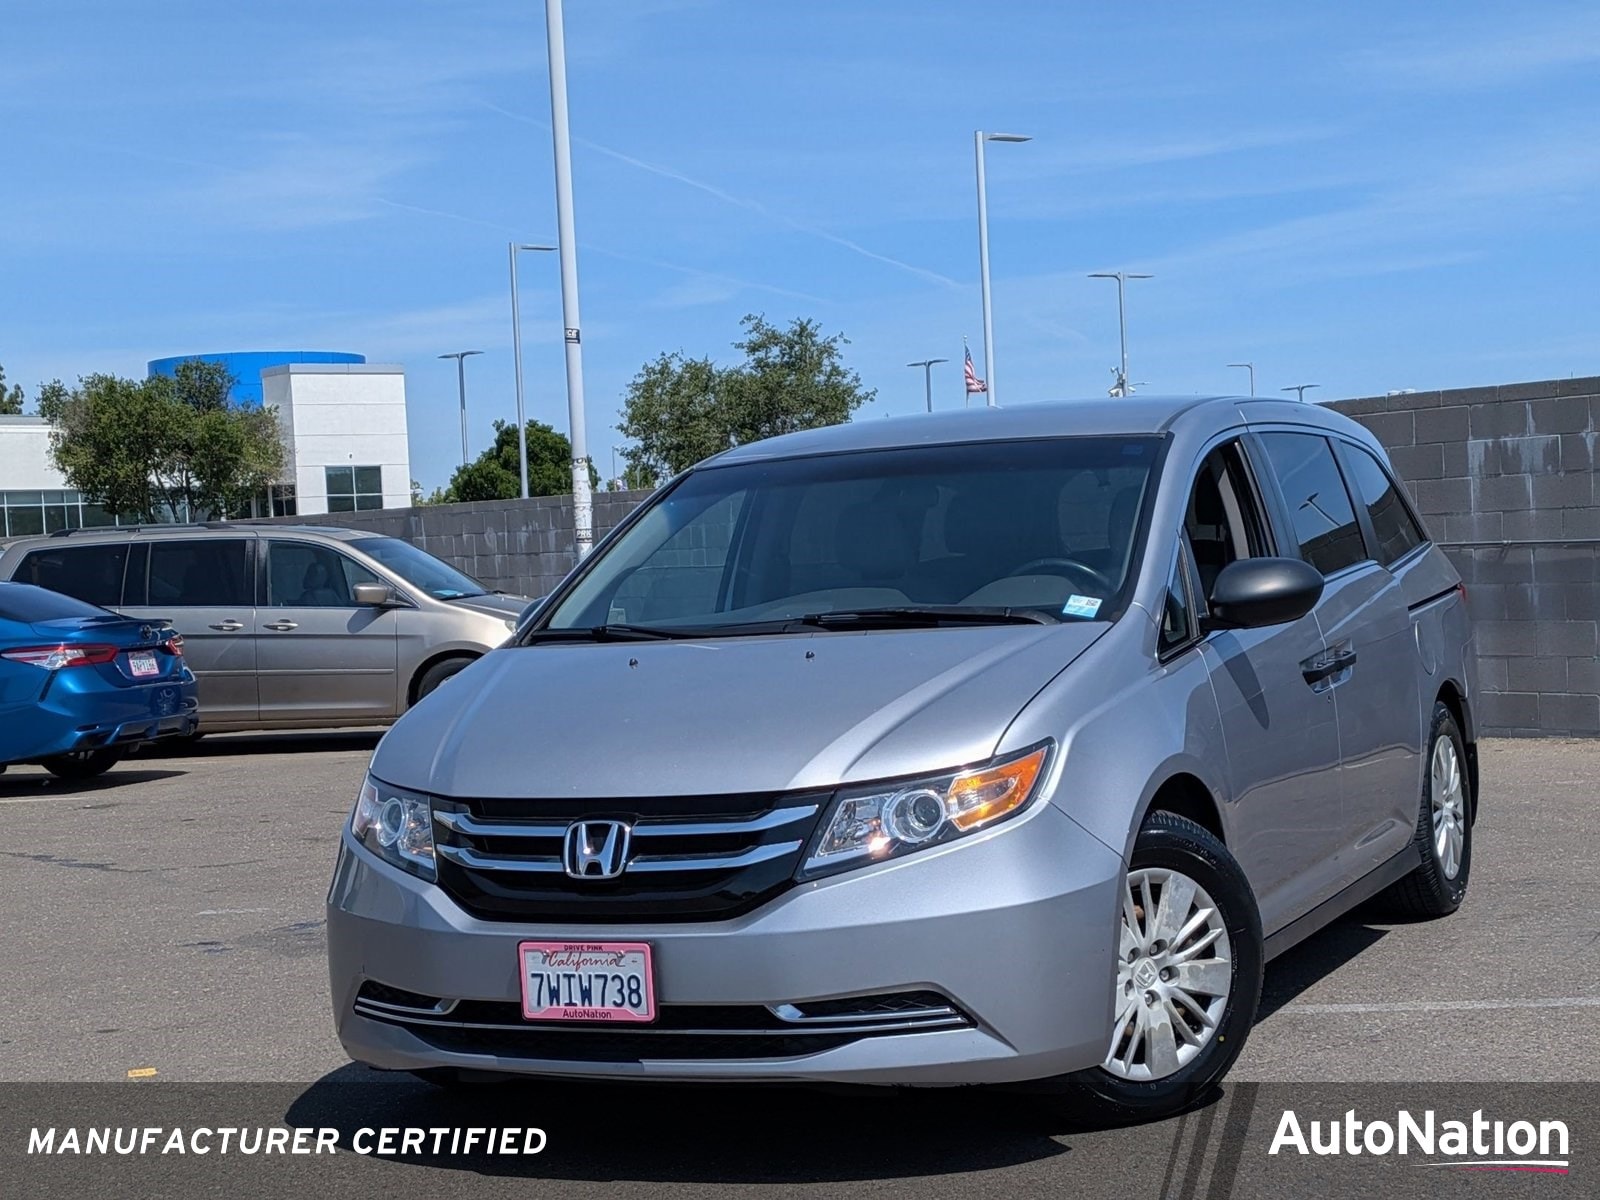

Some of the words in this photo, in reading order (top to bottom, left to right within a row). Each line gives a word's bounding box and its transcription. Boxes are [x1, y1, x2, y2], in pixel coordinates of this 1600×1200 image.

[548, 951, 625, 971] California
[531, 972, 643, 1009] 7WIW738
[562, 1009, 612, 1019] AutoNation
